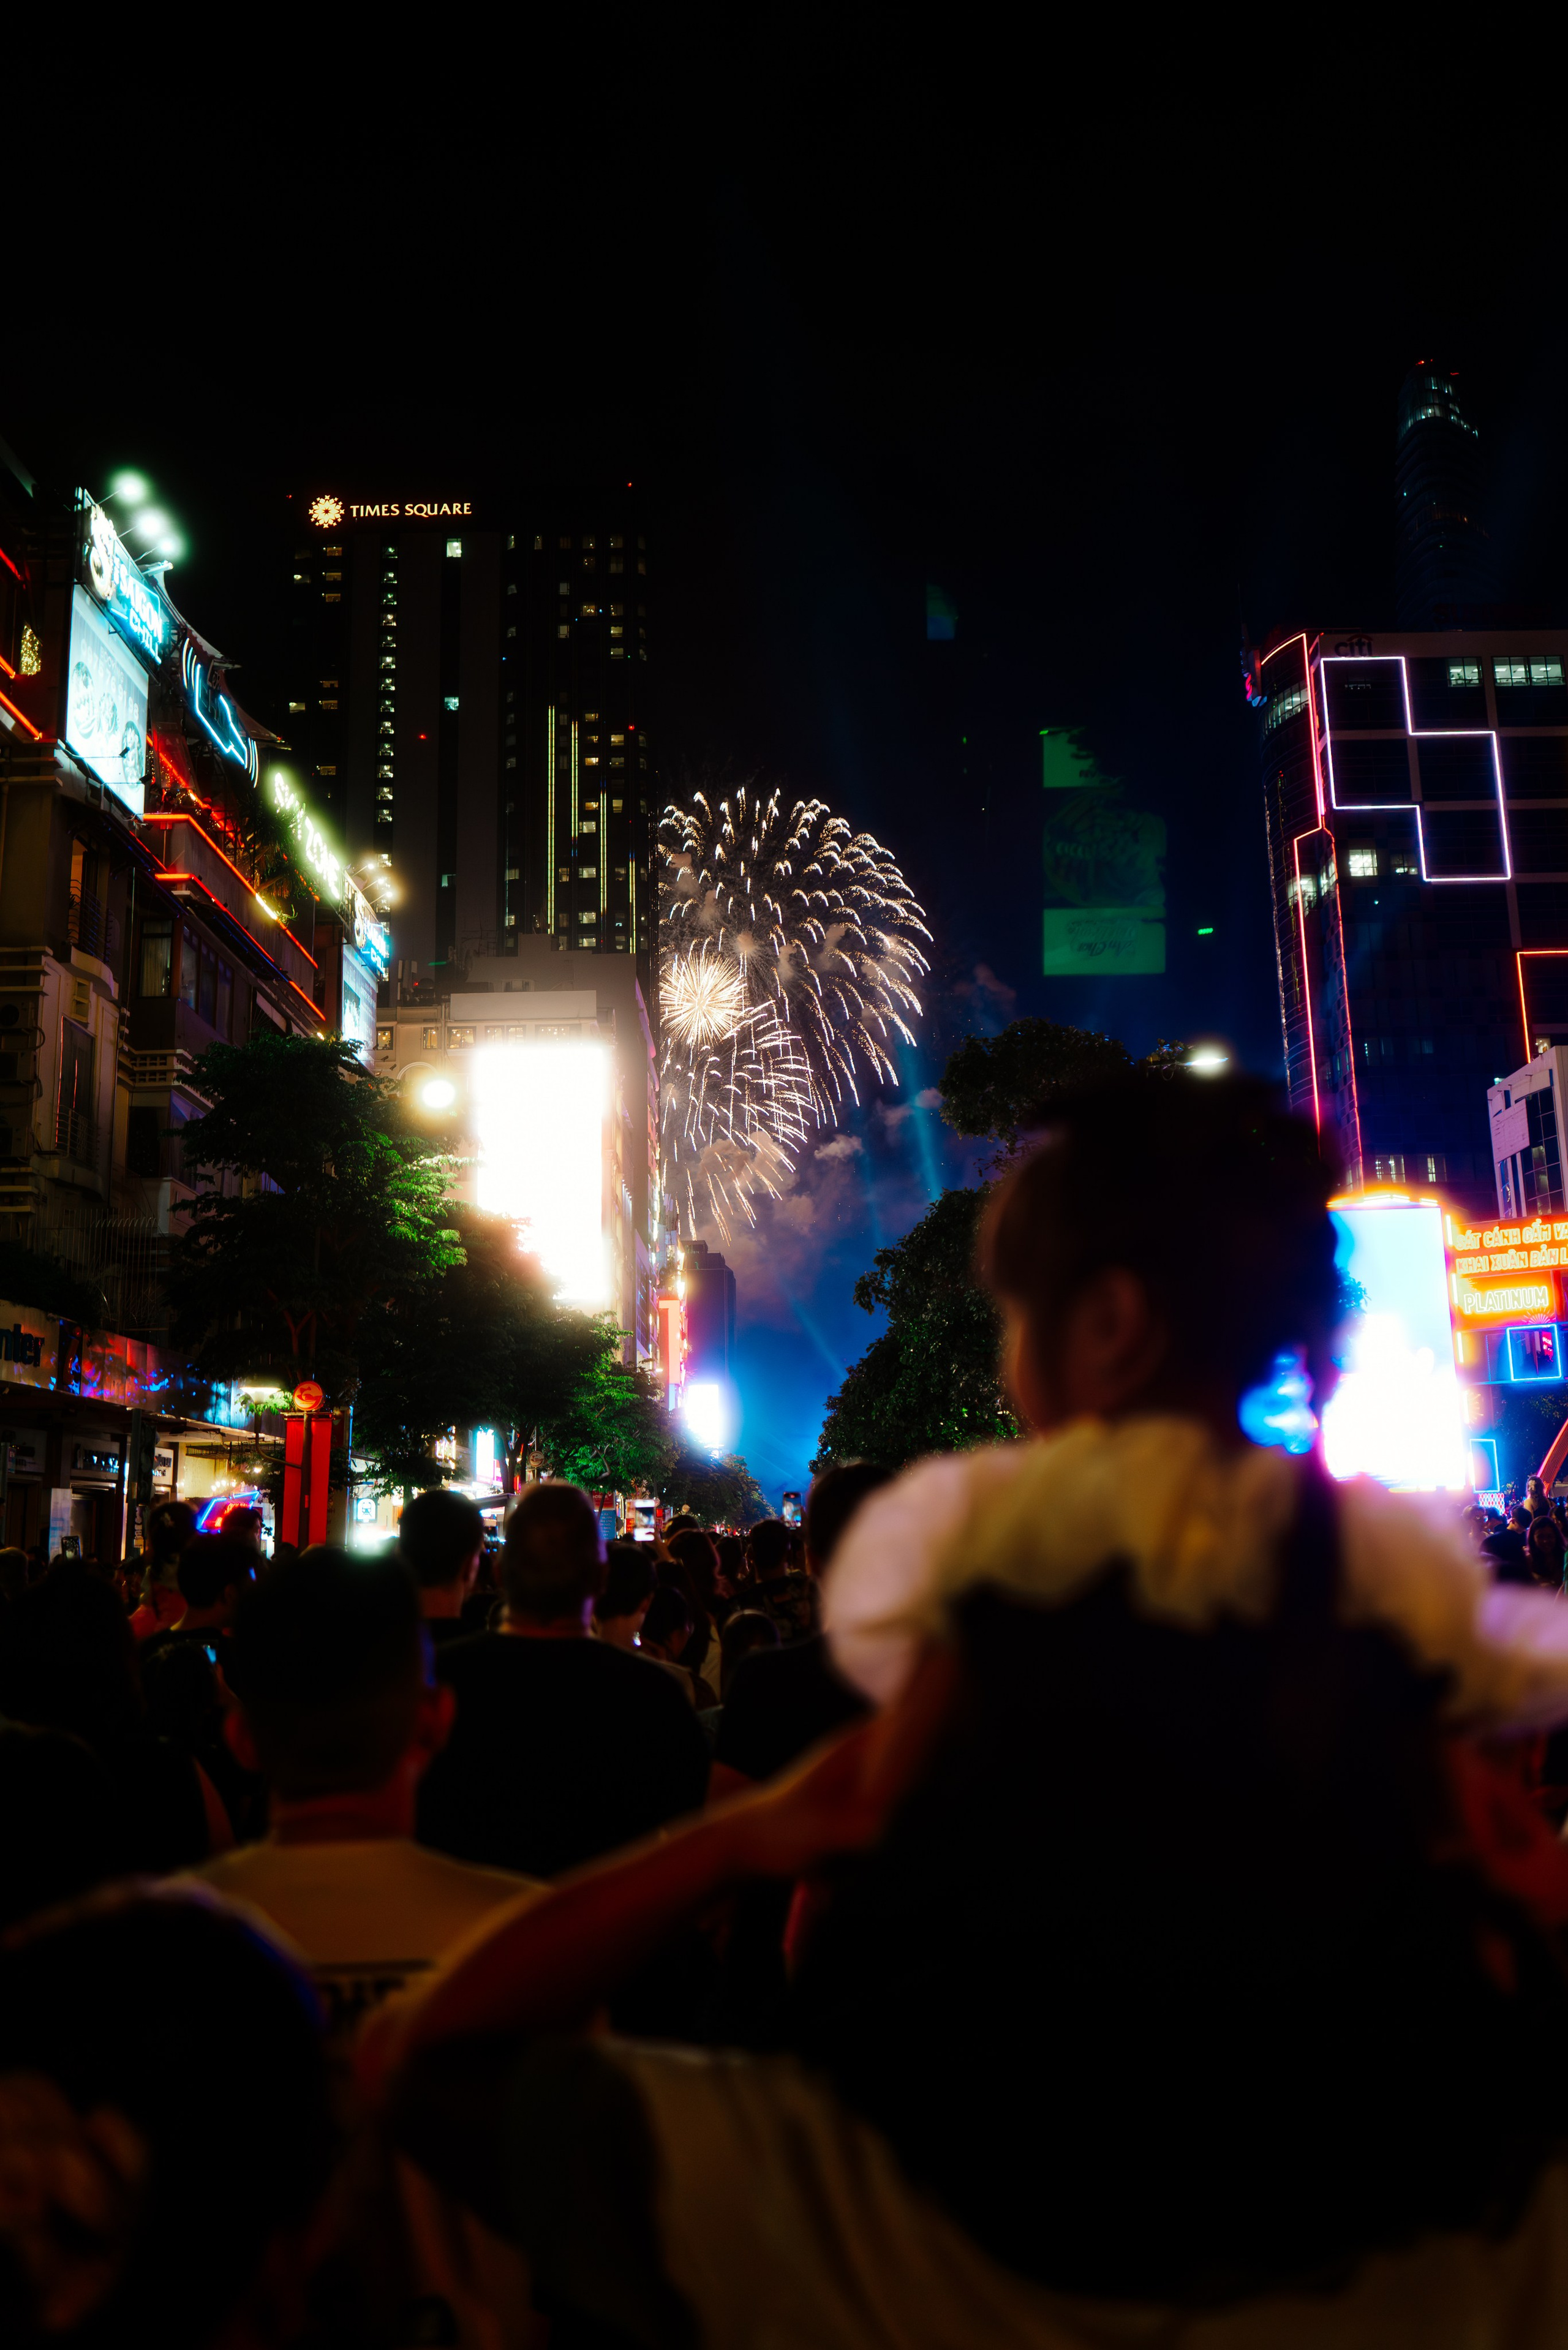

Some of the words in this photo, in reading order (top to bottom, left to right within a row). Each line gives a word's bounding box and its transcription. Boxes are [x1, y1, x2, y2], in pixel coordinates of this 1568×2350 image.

[350, 504, 399, 517] TIMES
[404, 502, 472, 518] SQUARE
[119, 563, 162, 644] SAIGON
[129, 608, 162, 665] CHILL
[1335, 635, 1373, 657] citi
[1456, 1230, 1482, 1250] SÁT
[1483, 1226, 1521, 1248] CÁNH
[1456, 1256, 1490, 1274] KHAI
[1490, 1249, 1528, 1271] XUÂN
[1530, 1244, 1559, 1267] BẢN
[1463, 1286, 1549, 1314] PLATINUM
